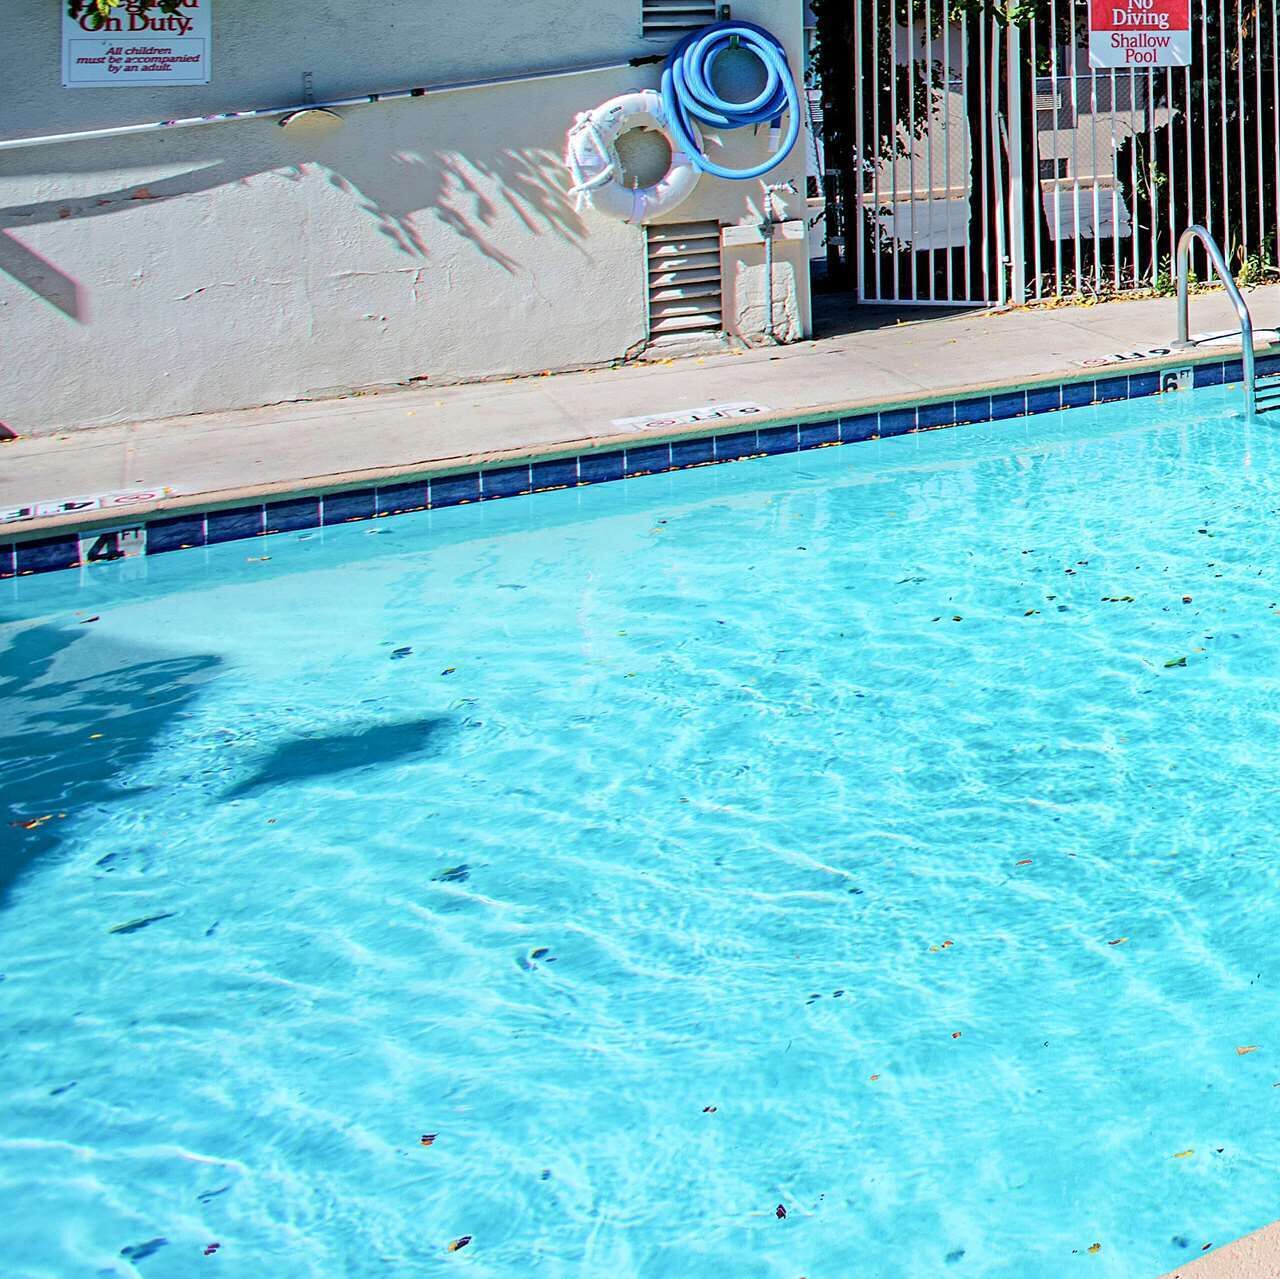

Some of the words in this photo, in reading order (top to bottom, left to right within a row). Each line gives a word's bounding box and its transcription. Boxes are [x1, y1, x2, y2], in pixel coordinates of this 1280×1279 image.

[80, 13, 122, 32] On
[128, 11, 193, 36] Duty.
[1112, 8, 1169, 29] Diving
[1111, 33, 1171, 48] Shallow
[105, 47, 123, 56] All
[125, 46, 172, 55] children
[1126, 49, 1157, 63] Pool
[76, 56, 107, 64] must
[109, 55, 123, 64] be
[124, 54, 201, 65] accompanied
[108, 64, 122, 74] by
[1163, 372, 1178, 393] 6
[1180, 369, 1191, 380] FT
[87, 531, 125, 563] 4
[121, 526, 143, 541] FT
